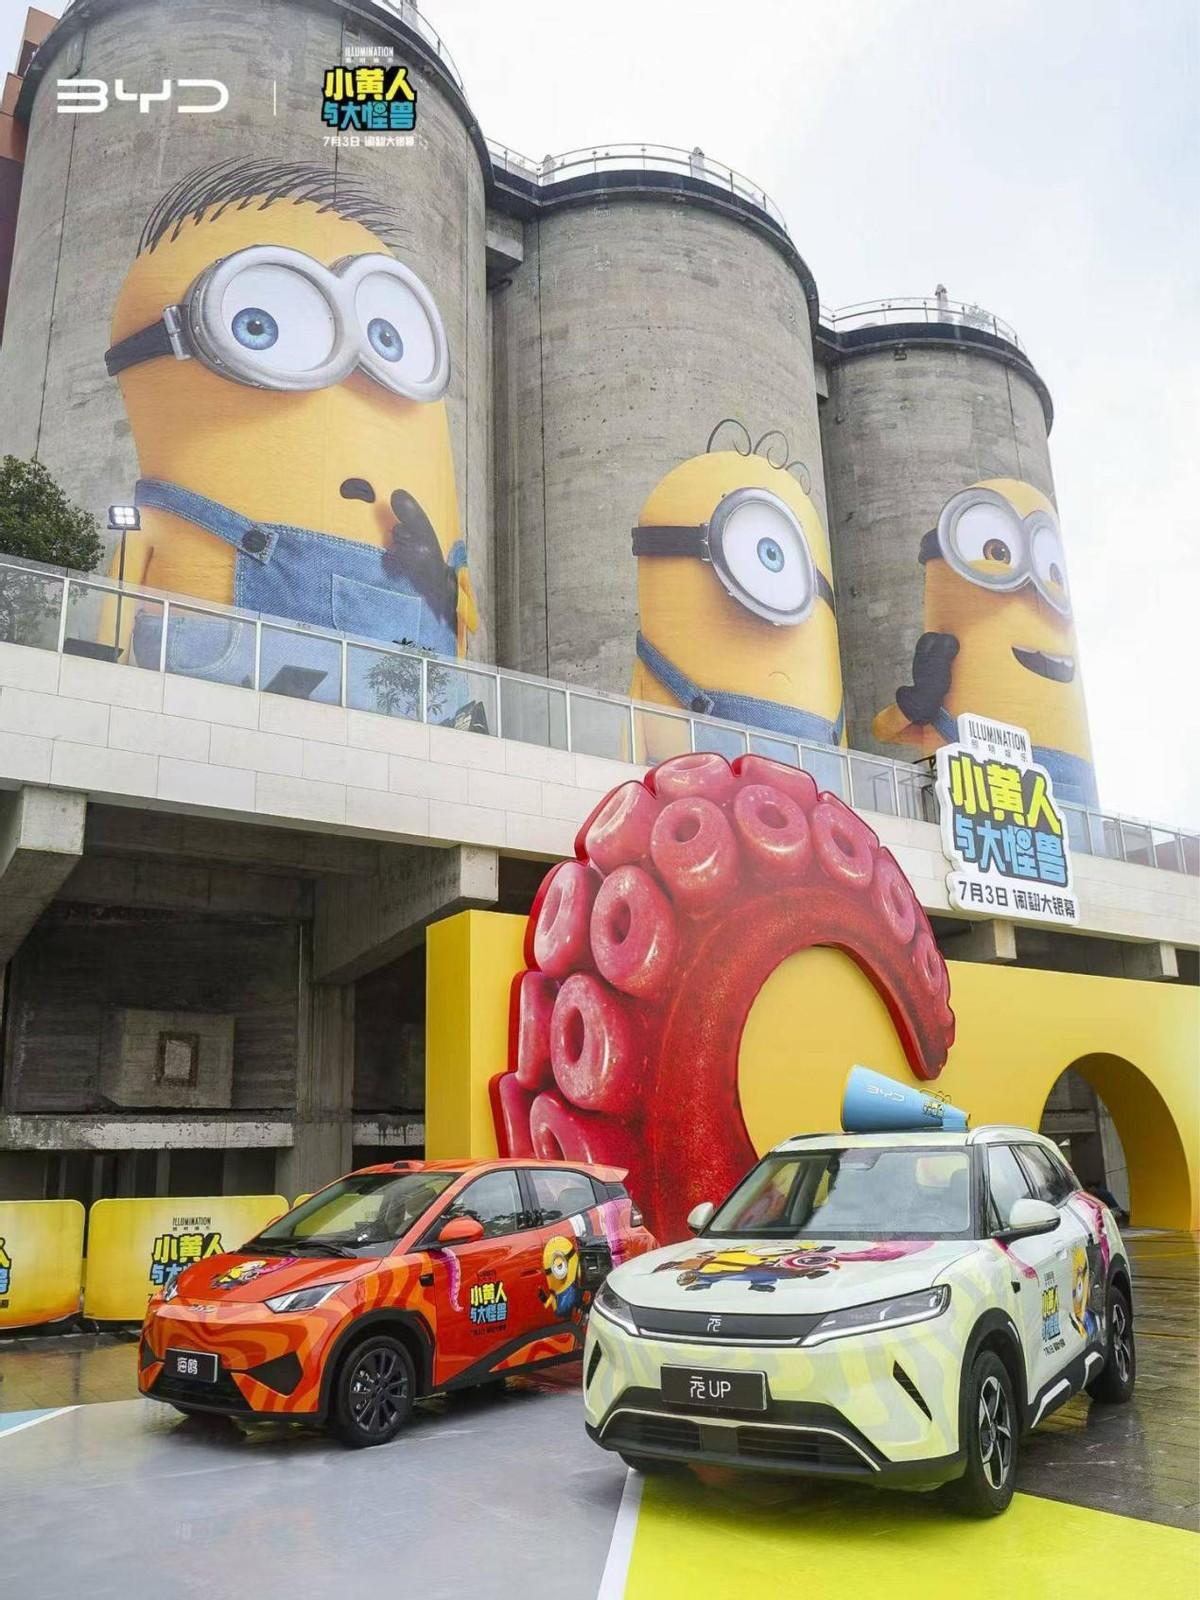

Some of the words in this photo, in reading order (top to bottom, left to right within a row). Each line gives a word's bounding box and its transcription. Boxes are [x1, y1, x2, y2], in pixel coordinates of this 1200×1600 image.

[968, 720, 1026, 752] ILLUMINATION
[950, 755, 1061, 836] 小黄人
[955, 813, 1066, 884] 与大怪兽
[958, 880, 1009, 907] 7月3日
[1013, 888, 1076, 919] 闹翻大银幕
[866, 1085, 905, 1102] BYD
[153, 1234, 223, 1263] 小黄人
[470, 1282, 508, 1306] 小黄人
[470, 1303, 507, 1324] 与大怪兽
